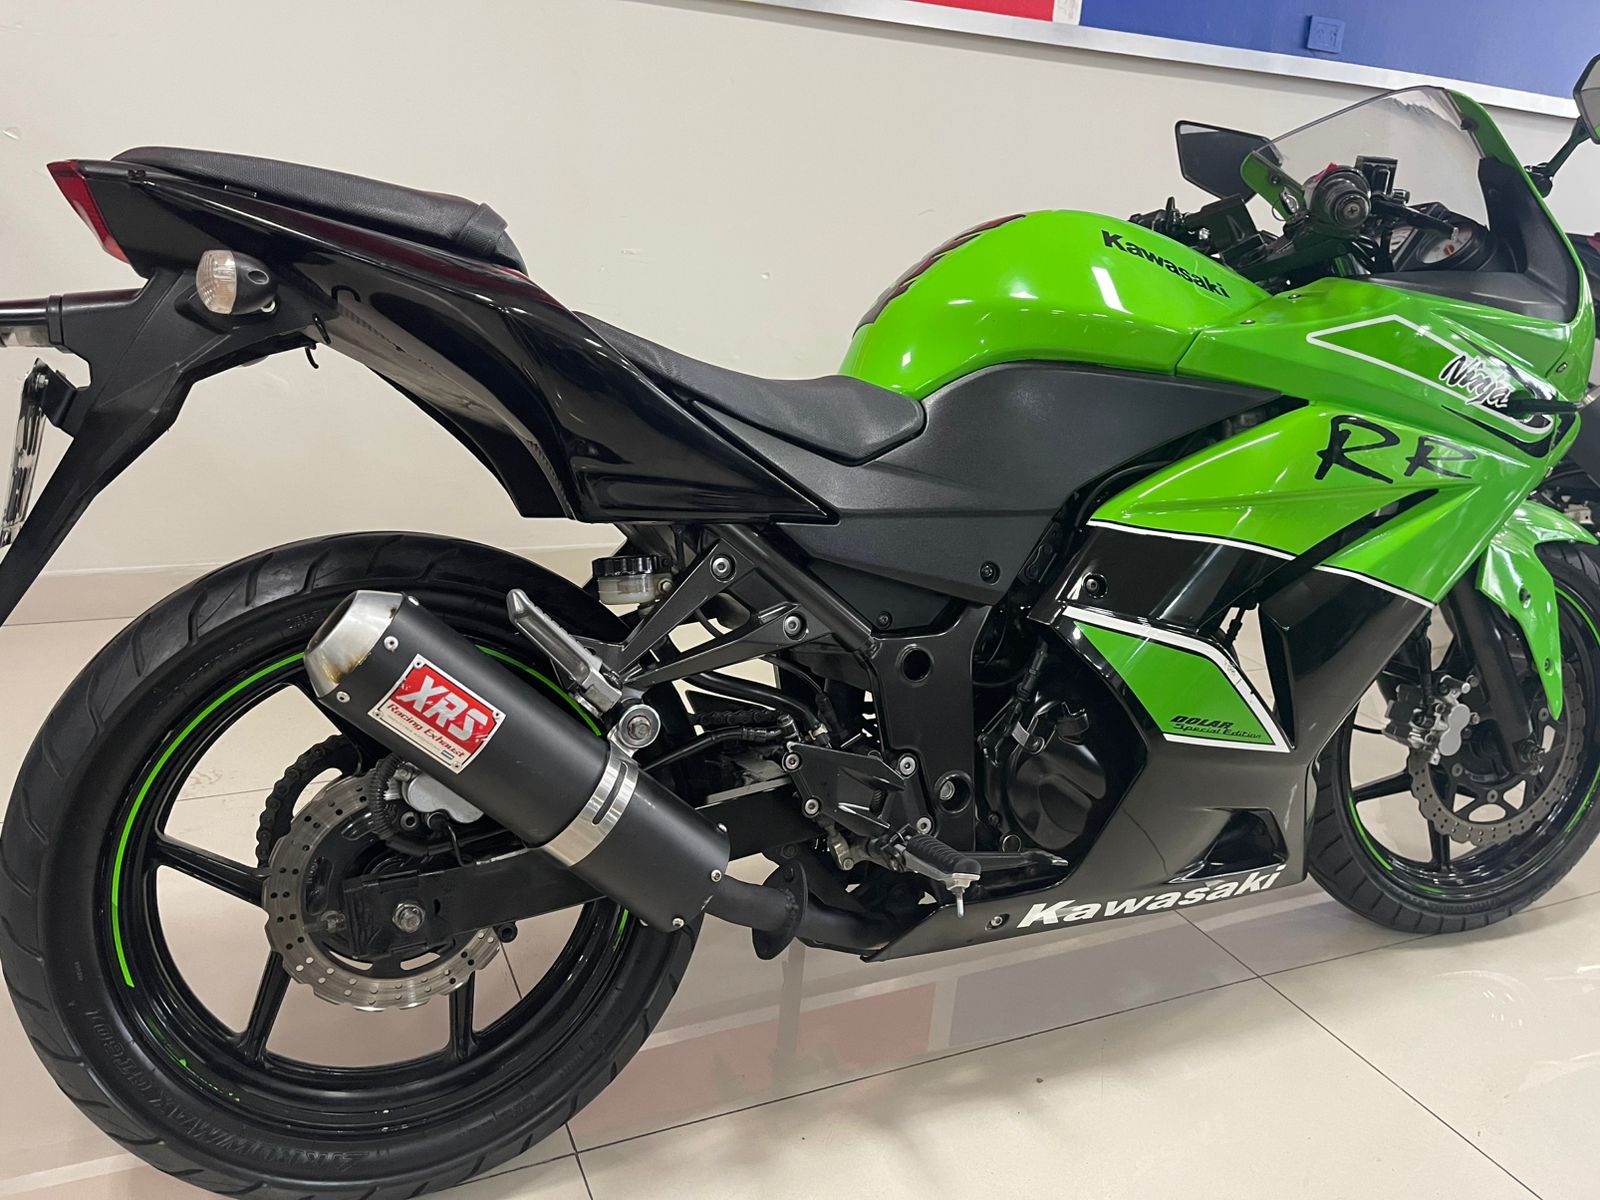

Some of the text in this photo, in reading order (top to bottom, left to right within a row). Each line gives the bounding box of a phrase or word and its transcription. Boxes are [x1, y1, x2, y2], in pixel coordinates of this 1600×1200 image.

[1101, 229, 1231, 299] Kawasaki
[1439, 353, 1510, 408] Ninja
[386, 702, 424, 732] Racing
[423, 726, 466, 759] Exhaust
[395, 674, 489, 742] XRS
[1170, 715, 1234, 730] DOLAR
[1173, 723, 1262, 739] Special Edition
[1016, 863, 1287, 930] Kawasaki
